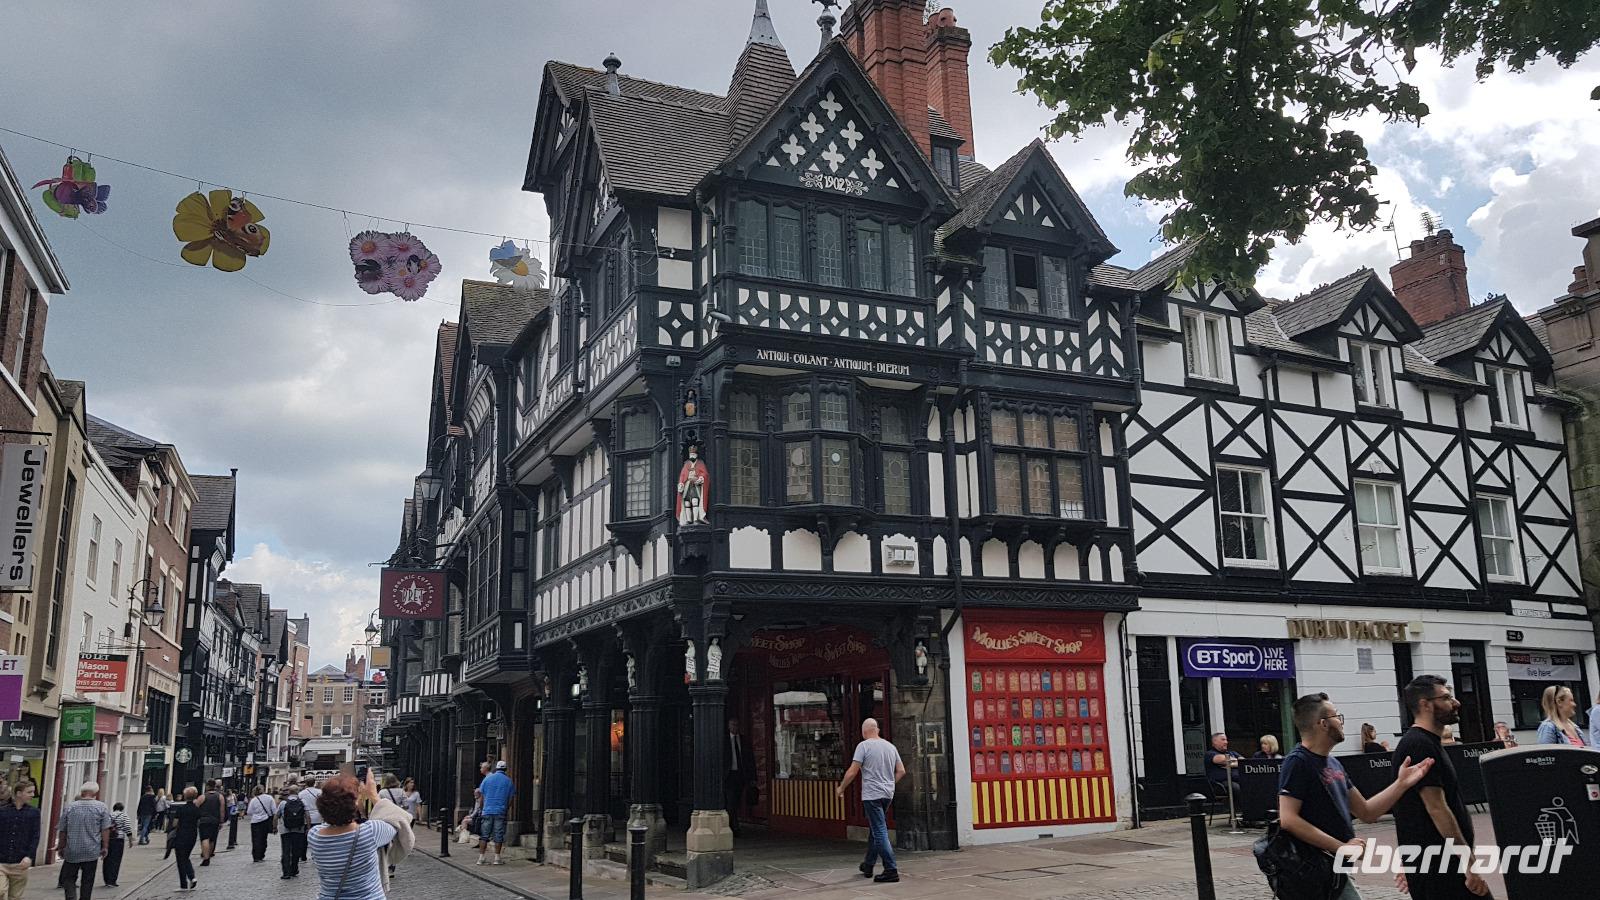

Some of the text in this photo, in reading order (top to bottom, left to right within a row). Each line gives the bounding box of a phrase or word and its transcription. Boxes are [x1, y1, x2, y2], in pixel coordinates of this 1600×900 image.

[823, 175, 846, 192] 1902
[793, 353, 828, 367] COLANT
[876, 362, 910, 375] DIERUM
[9, 449, 41, 581] Jewellers
[1286, 618, 1409, 642] DUBLIN PACKET
[1196, 648, 1256, 667] BT Sport
[1262, 646, 1285, 659] LIVE
[0, 659, 18, 671] ET
[78, 661, 109, 670] Mason
[1264, 658, 1288, 671] HERE
[77, 669, 118, 680] Partners
[1538, 667, 1552, 677] here
[1244, 764, 1276, 774] Dublin
[1369, 758, 1392, 768] Dublin
